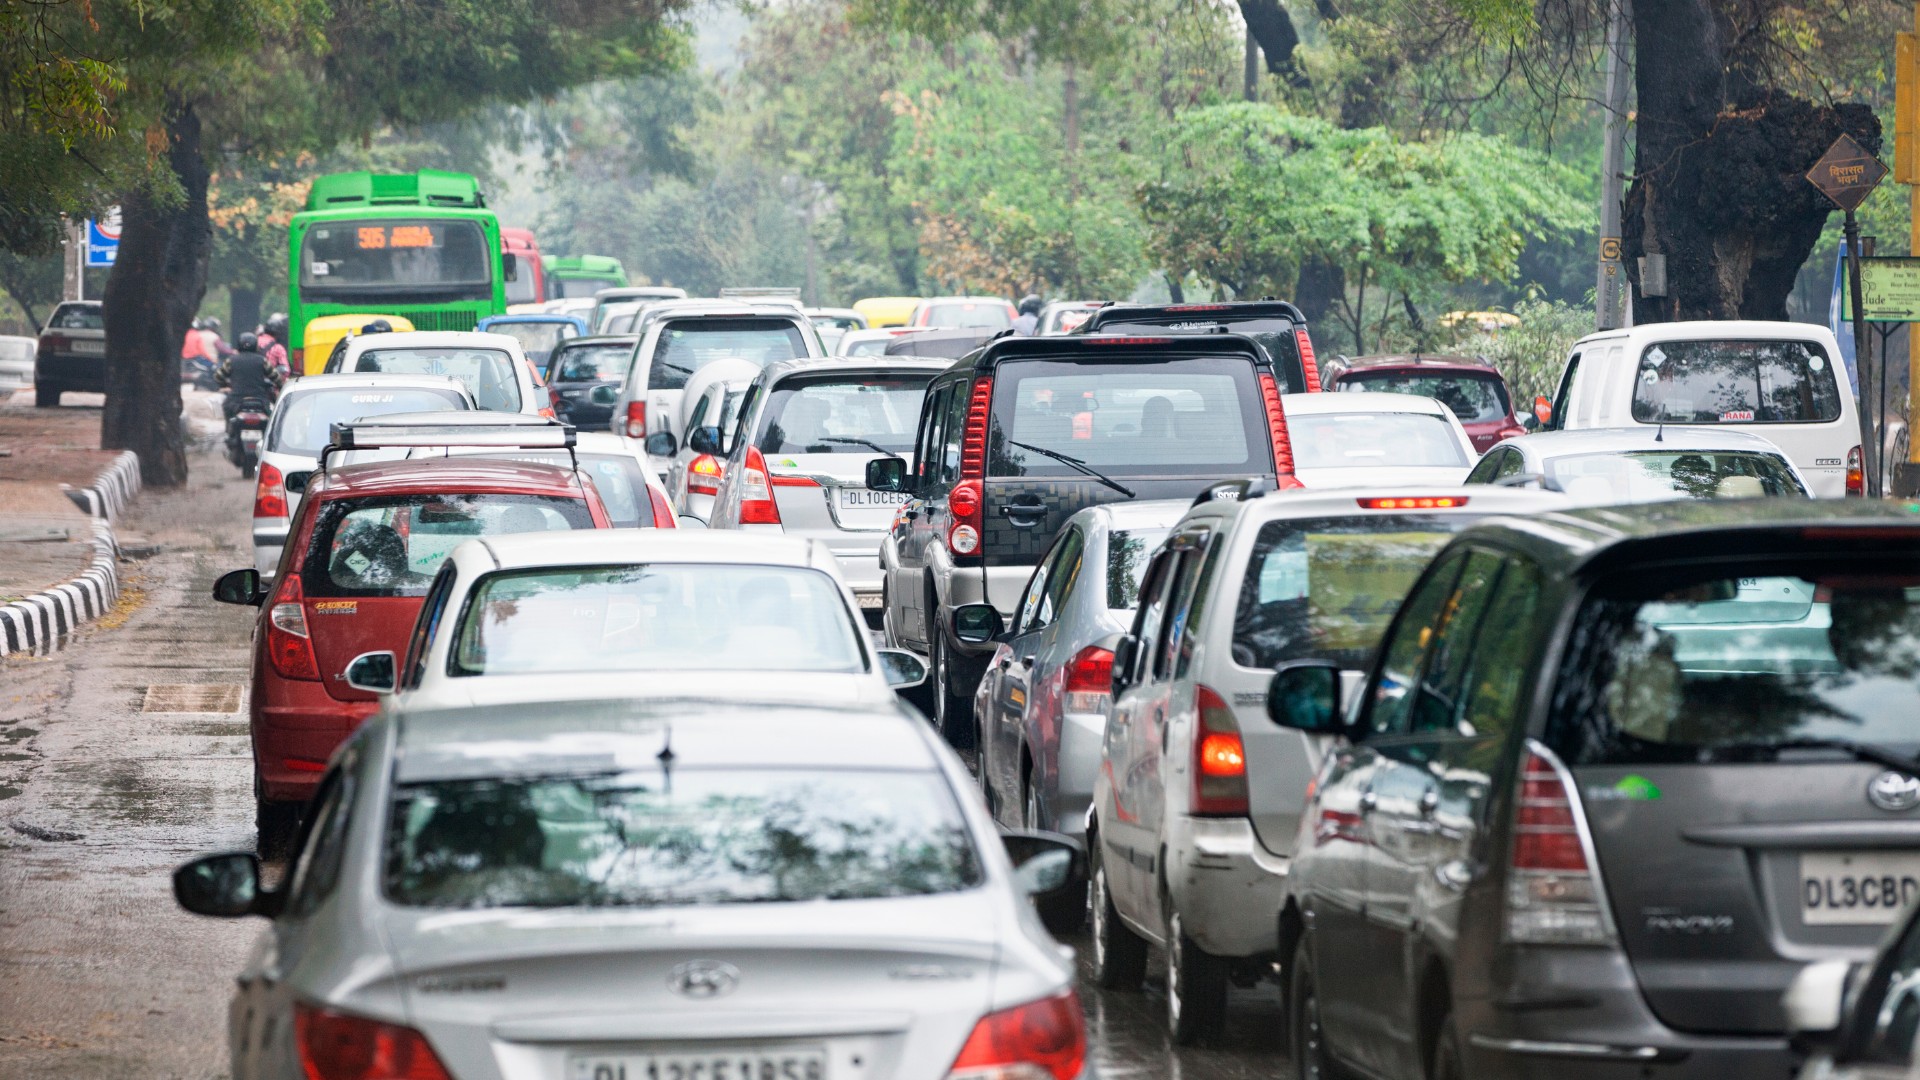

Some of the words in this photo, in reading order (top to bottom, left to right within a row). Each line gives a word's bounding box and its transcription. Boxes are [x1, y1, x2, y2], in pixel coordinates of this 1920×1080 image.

[1829, 165, 1865, 177] विरासत
[1837, 175, 1858, 184] भवन
[351, 394, 381, 403] GURU
[381, 394, 394, 403] JI
[1725, 412, 1752, 420] RANA
[850, 491, 909, 504] DL10CE6
